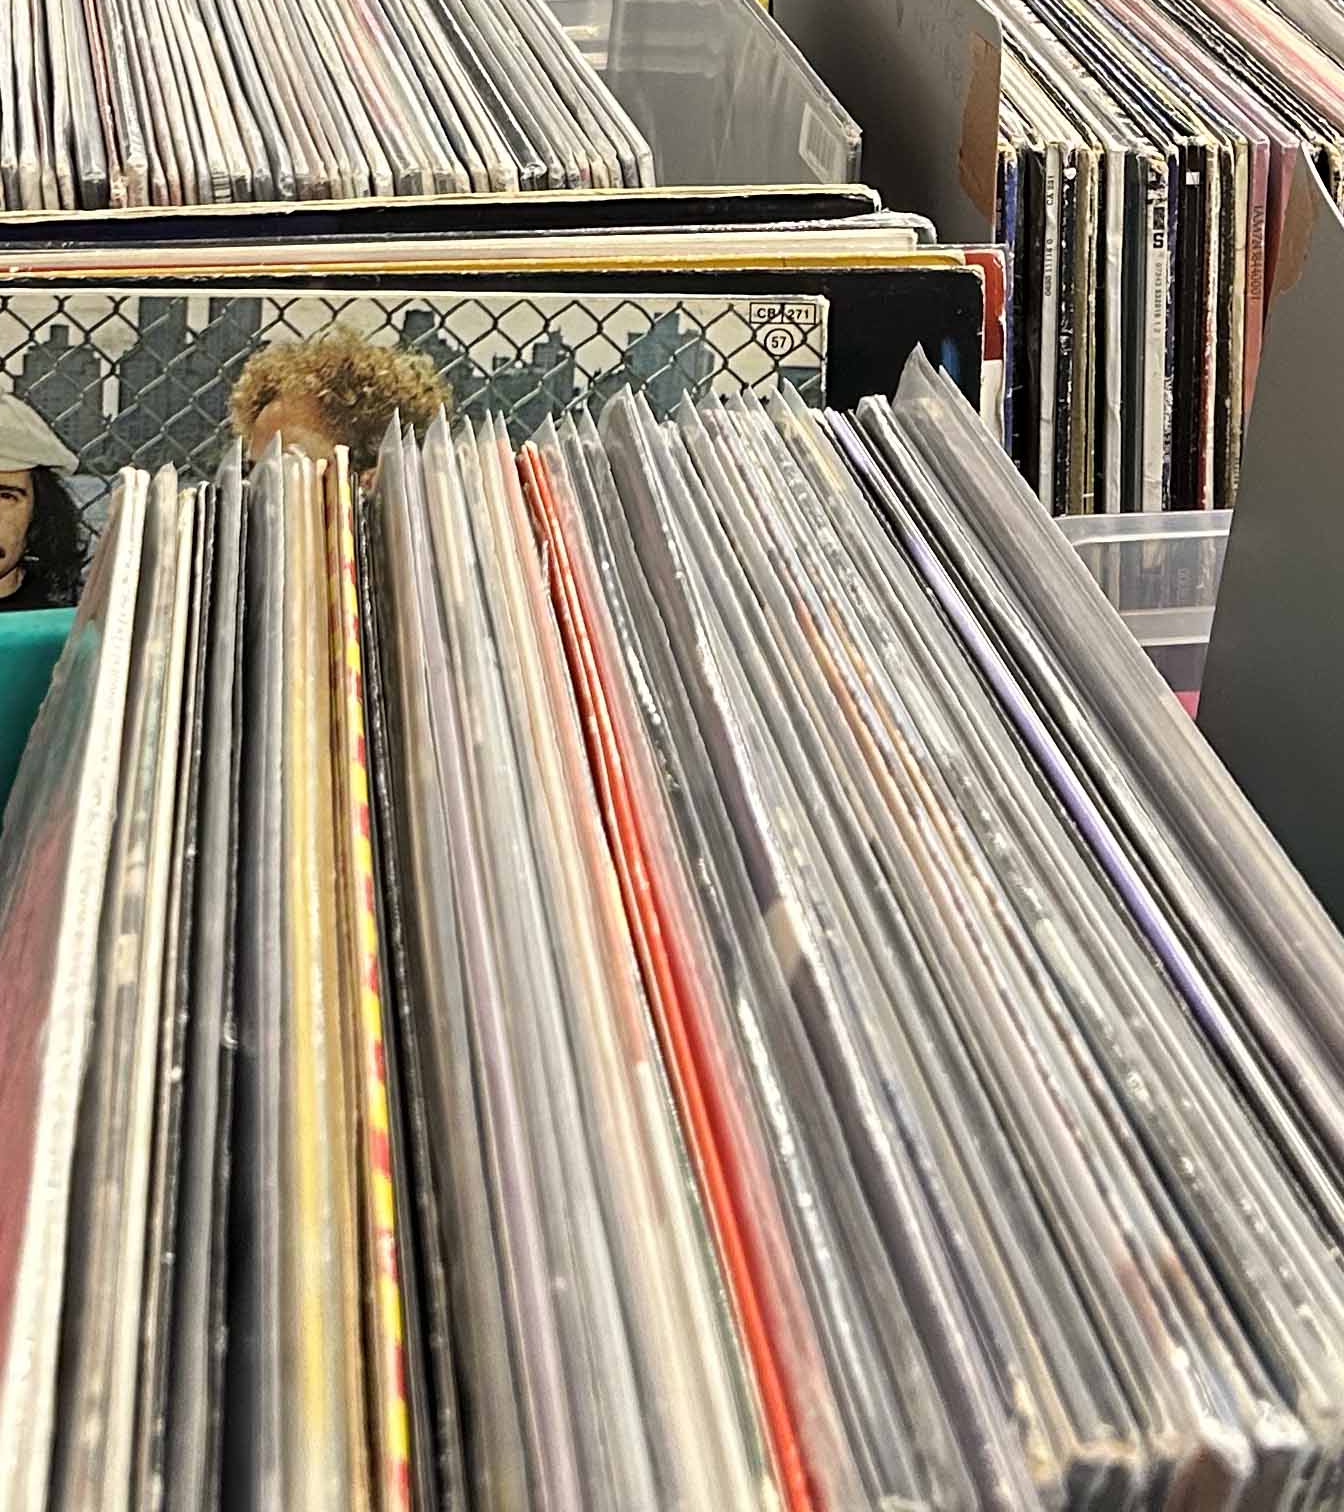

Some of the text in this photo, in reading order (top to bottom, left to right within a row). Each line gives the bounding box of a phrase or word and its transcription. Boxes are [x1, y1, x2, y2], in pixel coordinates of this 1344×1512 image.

[756, 307, 810, 321] CB 271
[770, 335, 787, 349] 57
